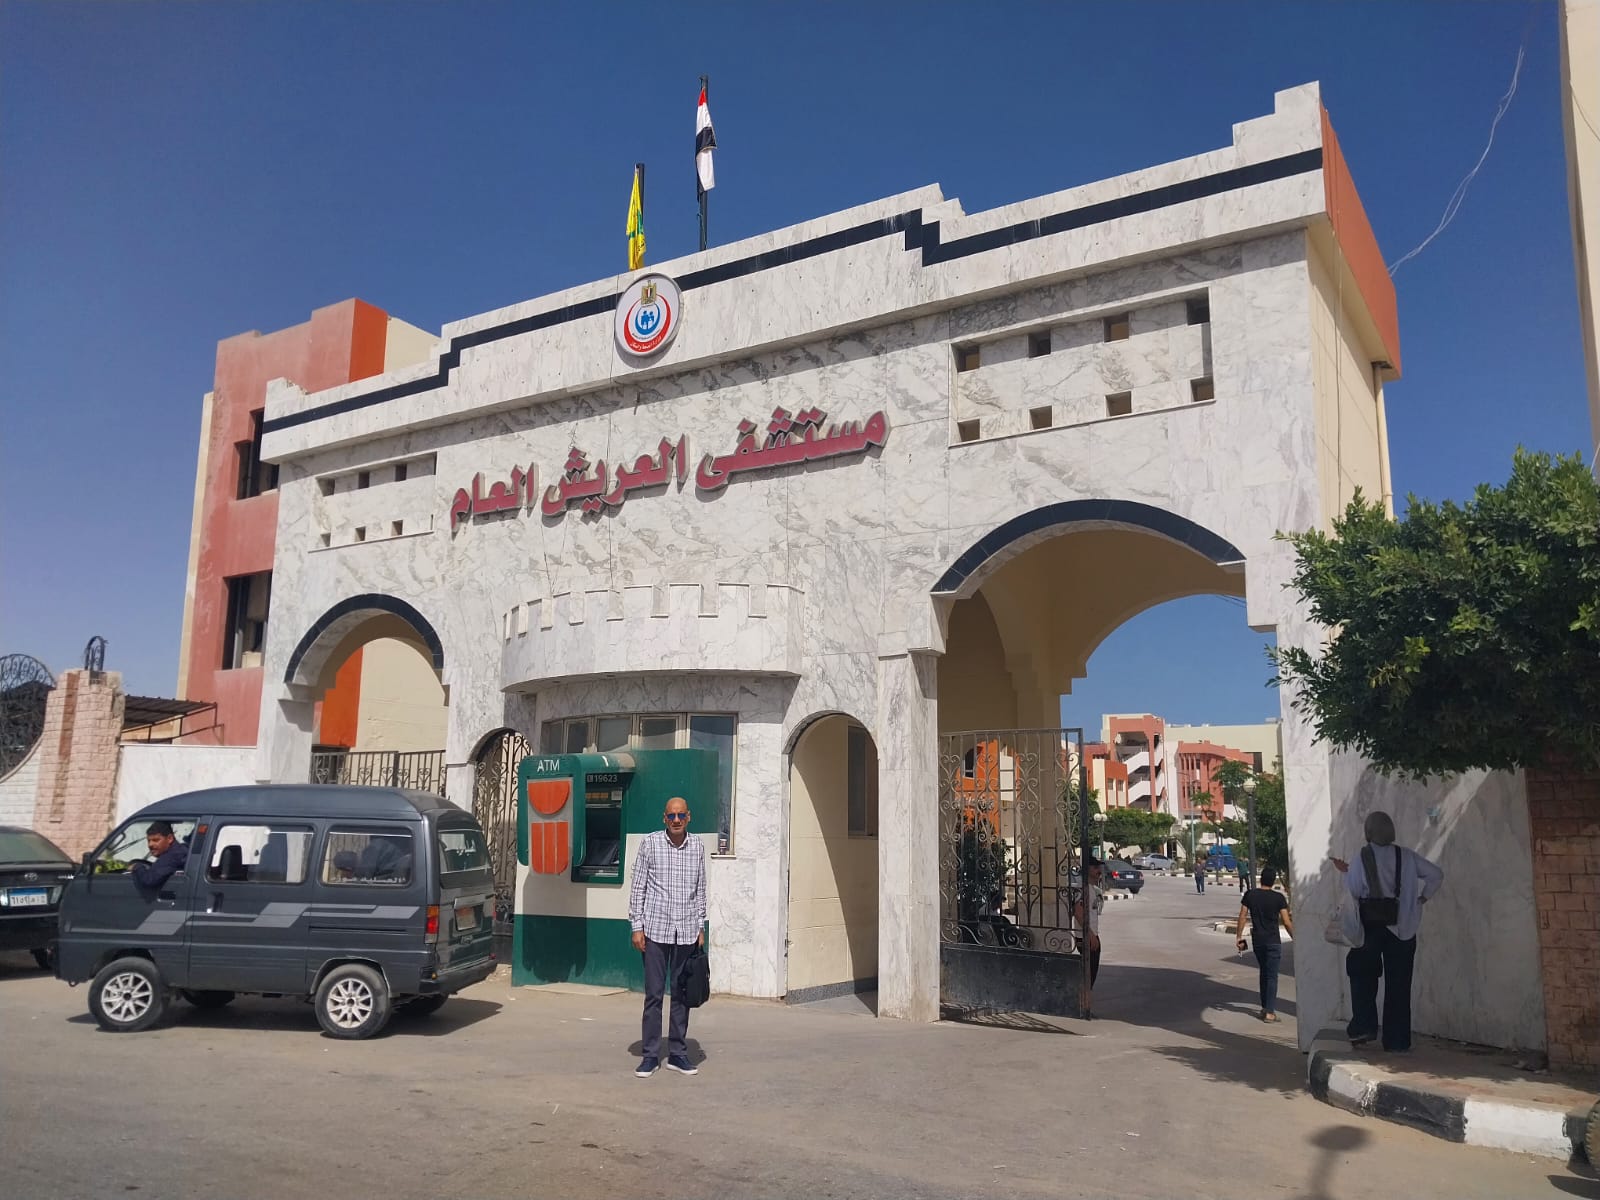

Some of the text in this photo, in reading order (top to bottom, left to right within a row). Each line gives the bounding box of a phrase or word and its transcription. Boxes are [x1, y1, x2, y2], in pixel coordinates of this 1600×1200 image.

[450, 405, 890, 532] مستشفى العريش العام
[537, 759, 560, 772] ATM
[594, 774, 618, 783] 19623
